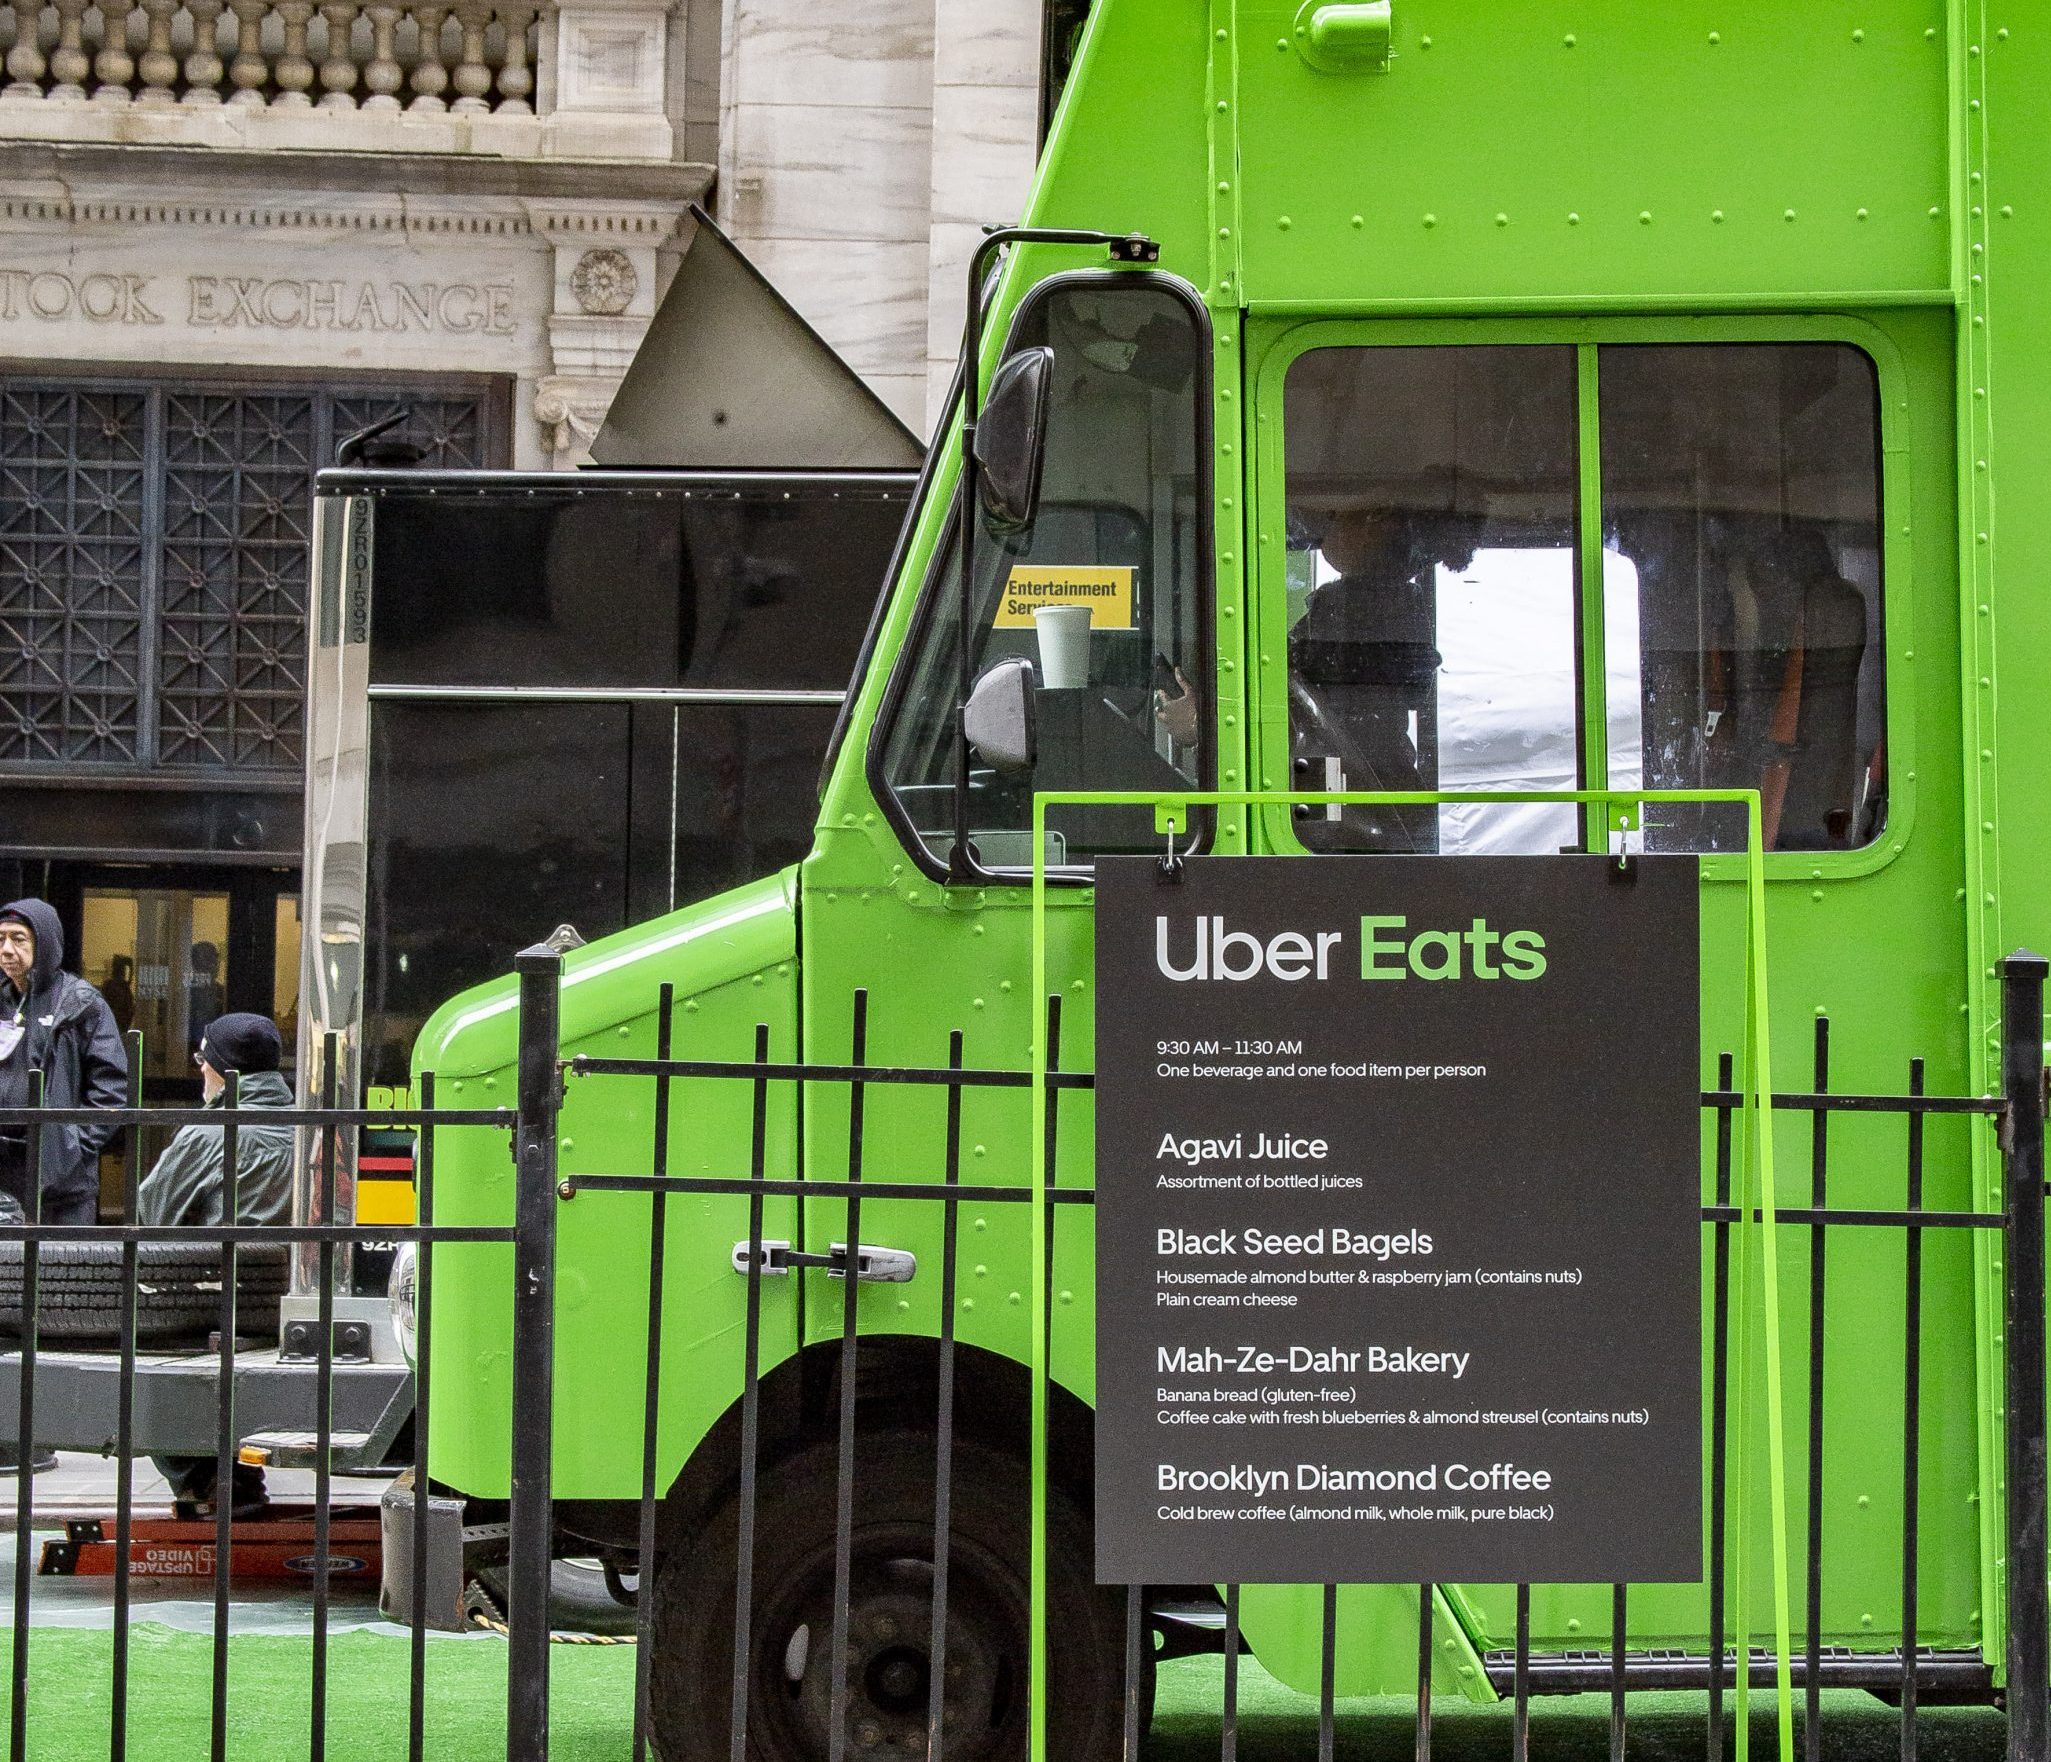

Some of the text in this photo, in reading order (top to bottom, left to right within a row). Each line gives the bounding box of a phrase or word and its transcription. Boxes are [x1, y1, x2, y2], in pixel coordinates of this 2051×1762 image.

[187, 276, 519, 337] EXCHANGE
[1008, 580, 1117, 597] Entertainment
[1156, 915, 1548, 982] Uber Eats
[1156, 1040, 1191, 1055] 9:30
[1192, 1040, 1220, 1055] AM
[1234, 1040, 1274, 1055] 11:30
[1275, 1040, 1303, 1055] AM
[1156, 1062, 1487, 1081] One beverage and one food item per person
[1155, 1132, 1329, 1166] Agavi Juice
[1155, 1173, 1364, 1192] Assortment of bottled juices
[1157, 1227, 1434, 1262] Black Seed Bagels
[1156, 1267, 1583, 1287] Housemade almond butter & raspberry jam (contains nuts)
[1156, 1292, 1299, 1307] Plain cream cheese
[1157, 1345, 1471, 1380] Mah-Ze-Dahr Bakery
[1156, 1386, 1357, 1406] Banana bread (gluten-free)
[1156, 1407, 1650, 1426] Coffee cake with fresh blueberries & almond streusel (contains nuts)
[1157, 1462, 1552, 1498] Brooklyn Diamond Coffee
[1156, 1503, 1555, 1523] Cold brew coffee (almond milk, whole milk, pure black)
[146, 1549, 194, 1562] VIDEO
[128, 1561, 193, 1574] UPSTAGE
